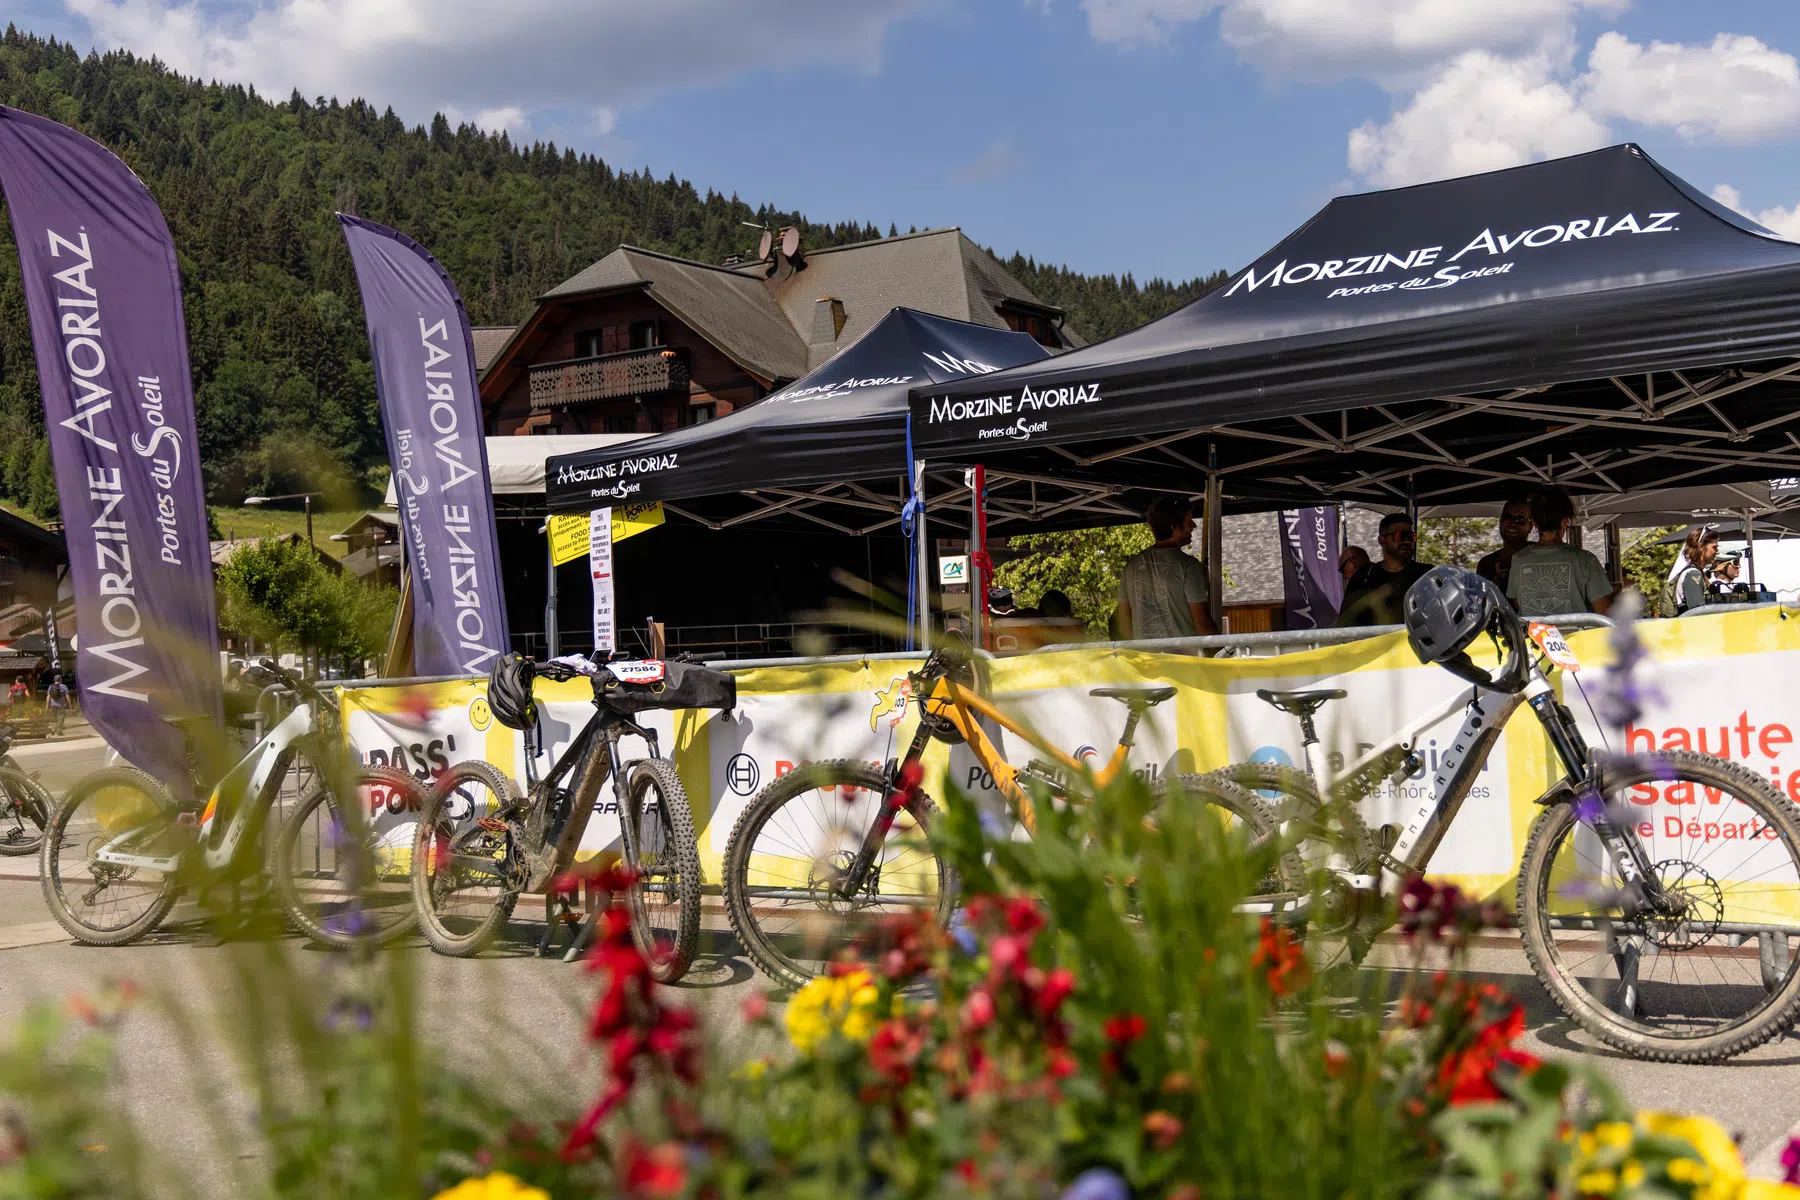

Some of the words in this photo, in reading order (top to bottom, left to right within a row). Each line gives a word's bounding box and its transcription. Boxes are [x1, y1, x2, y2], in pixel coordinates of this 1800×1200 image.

[1222, 246, 1443, 298] MORZINE
[1446, 212, 1680, 263] AVORIAZ
[1327, 280, 1399, 299] Portes
[1400, 276, 1433, 290] du
[1429, 262, 1515, 288] Soleil
[47, 225, 119, 454] AVORIAZ
[759, 383, 837, 406] MORZINE
[929, 395, 1012, 424] MORZINE
[1017, 383, 1102, 412] AVORIAZ
[132, 376, 183, 480] Soleil
[978, 428, 1004, 439] Portes
[1005, 426, 1017, 435] du
[1013, 417, 1048, 441] Soleil
[151, 458, 172, 489] du
[557, 463, 617, 485] MORZINE
[591, 487, 610, 498] Portes
[610, 485, 619, 496] du
[615, 480, 640, 499] Soleil
[157, 492, 182, 565] Portes
[570, 529, 588, 541] FOOD
[1315, 516, 1328, 561] Portes
[86, 465, 150, 703] MORZINE
[1625, 710, 1793, 760] haute
[1664, 816, 1780, 843] Départe
